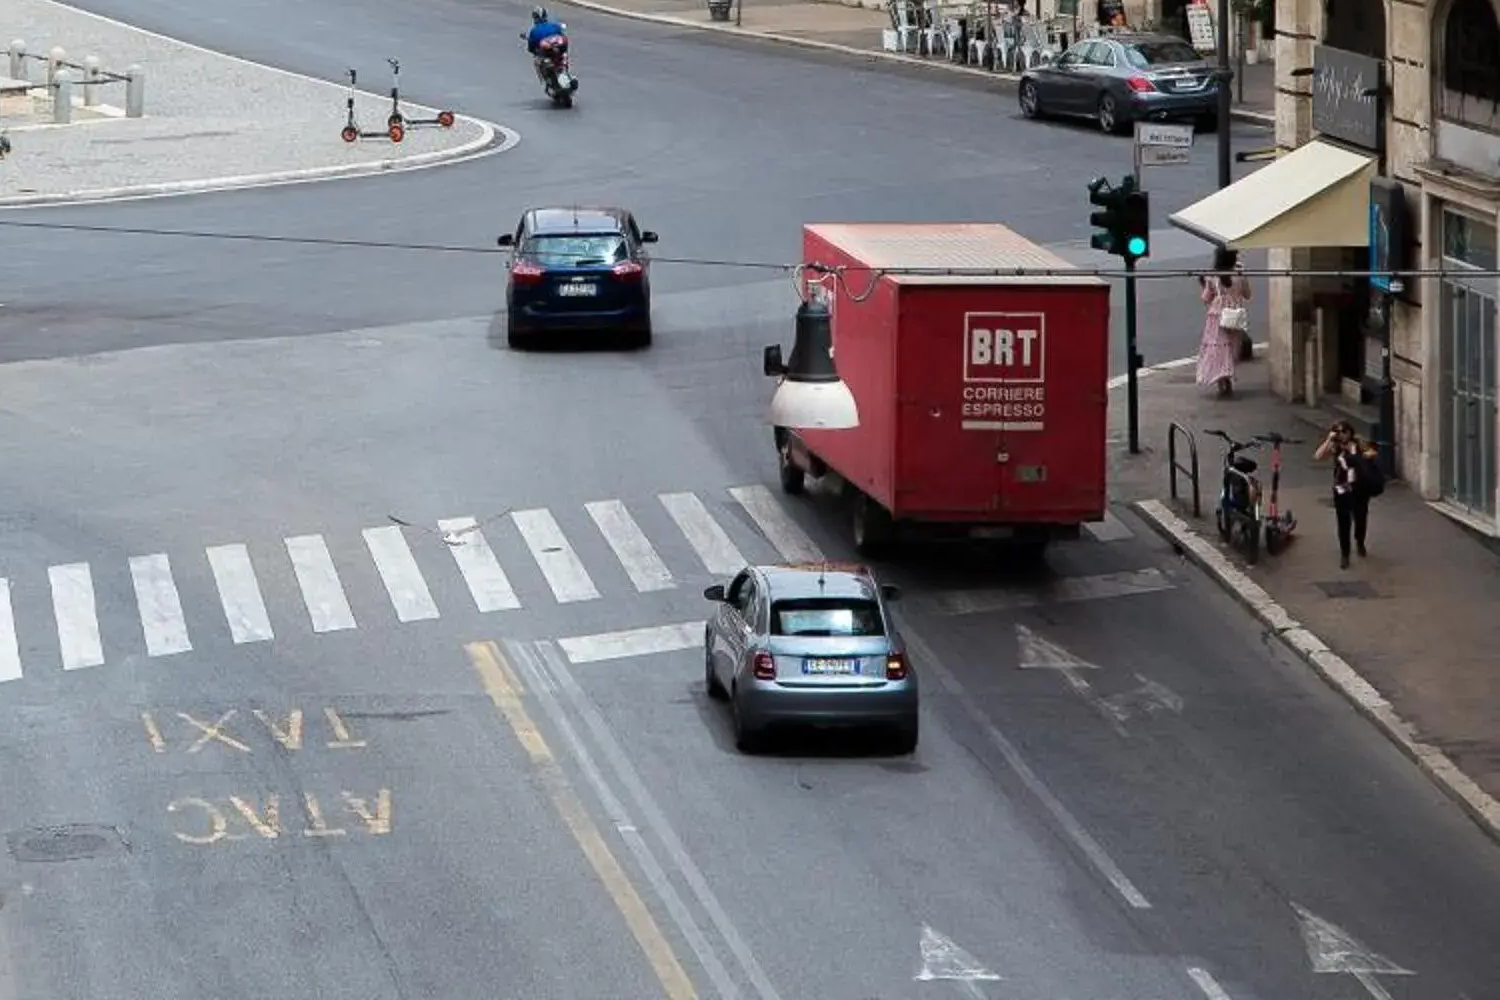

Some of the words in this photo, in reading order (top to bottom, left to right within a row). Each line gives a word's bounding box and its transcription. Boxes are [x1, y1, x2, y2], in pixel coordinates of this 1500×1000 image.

[971, 328, 1038, 366] BRT
[963, 387, 1045, 401] CORRIERE
[962, 402, 1045, 417] ESPRESSO
[141, 706, 368, 753] TAXI
